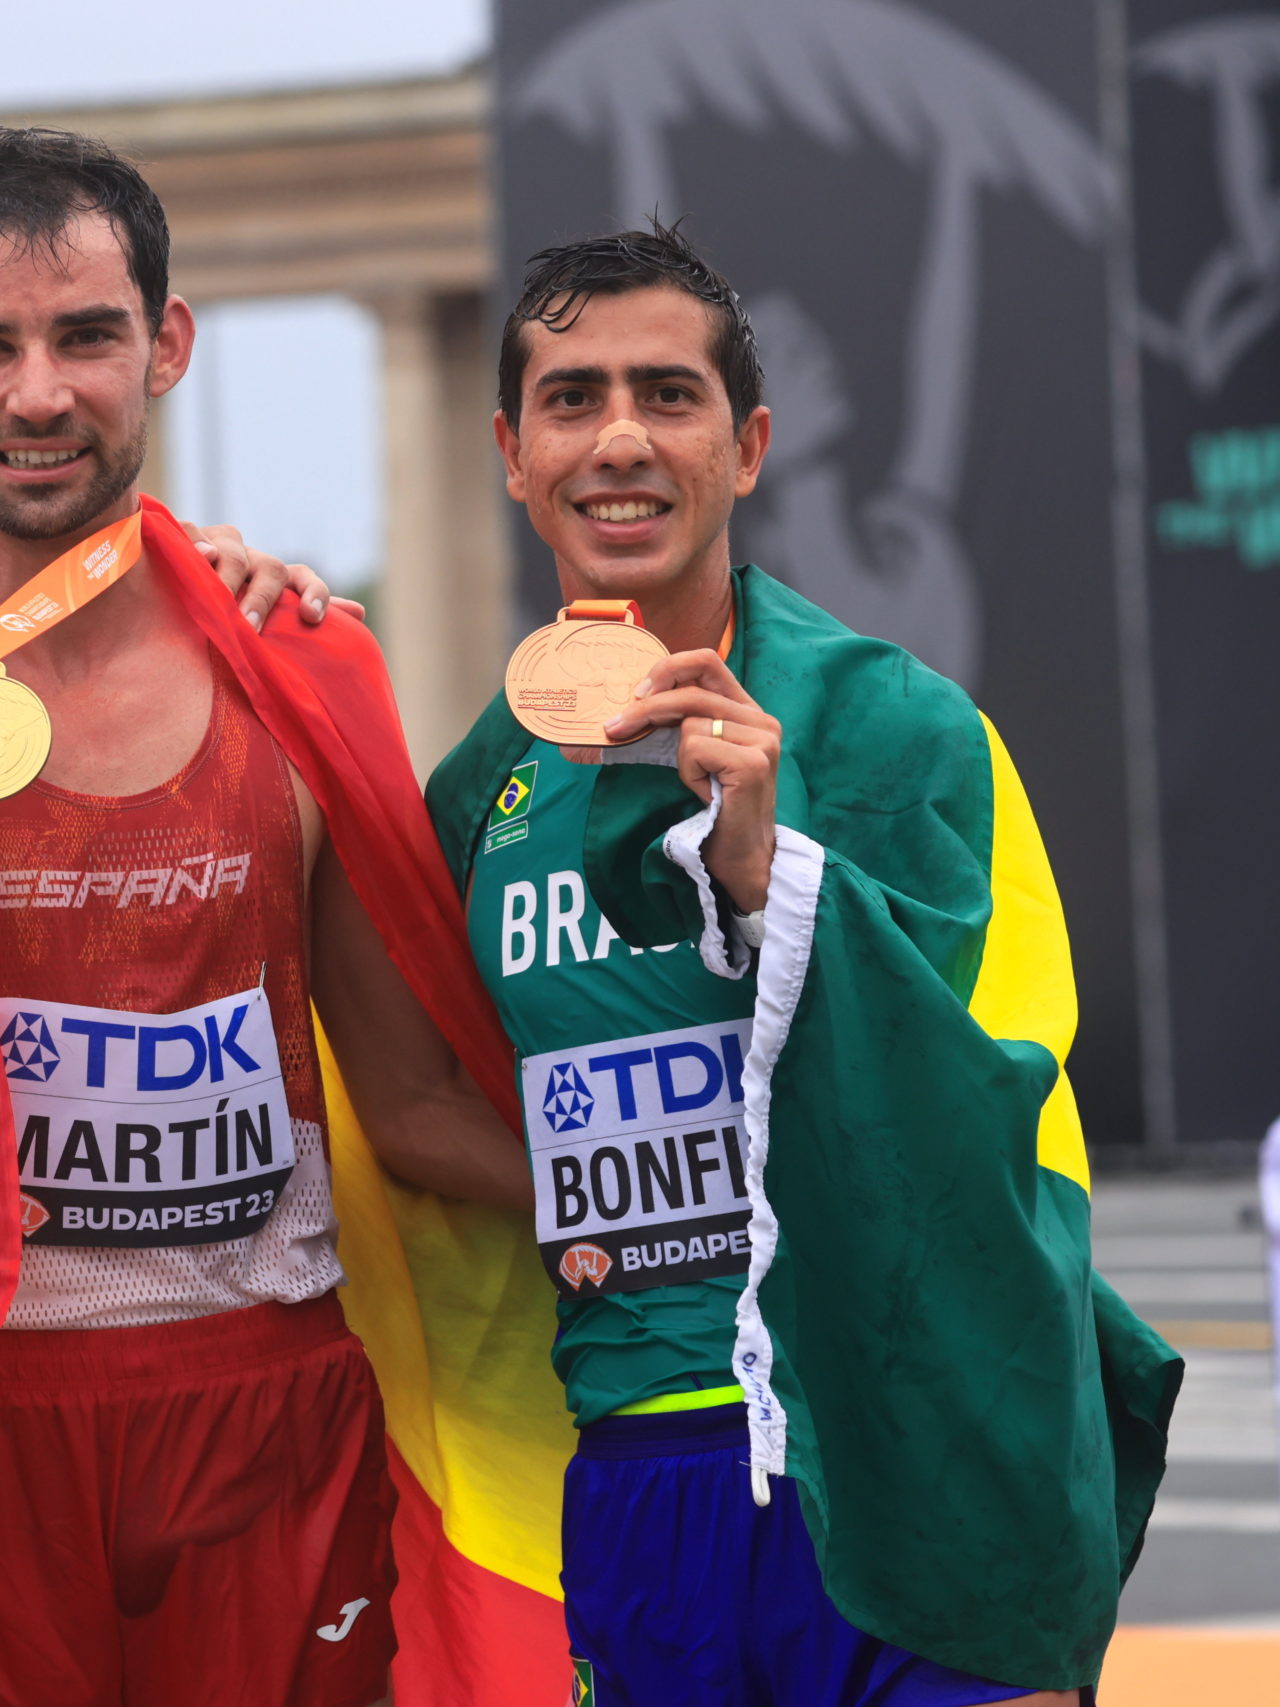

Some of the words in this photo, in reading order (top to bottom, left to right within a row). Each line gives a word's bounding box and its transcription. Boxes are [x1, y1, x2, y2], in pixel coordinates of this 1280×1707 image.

[61, 1003, 262, 1091] TDK
[17, 1097, 274, 1184] MARTÍN
[551, 1125, 752, 1230] BONFI
[61, 1201, 242, 1232] BUDAPEST
[245, 1188, 276, 1216] 23
[620, 1230, 752, 1272] BUDAPE
